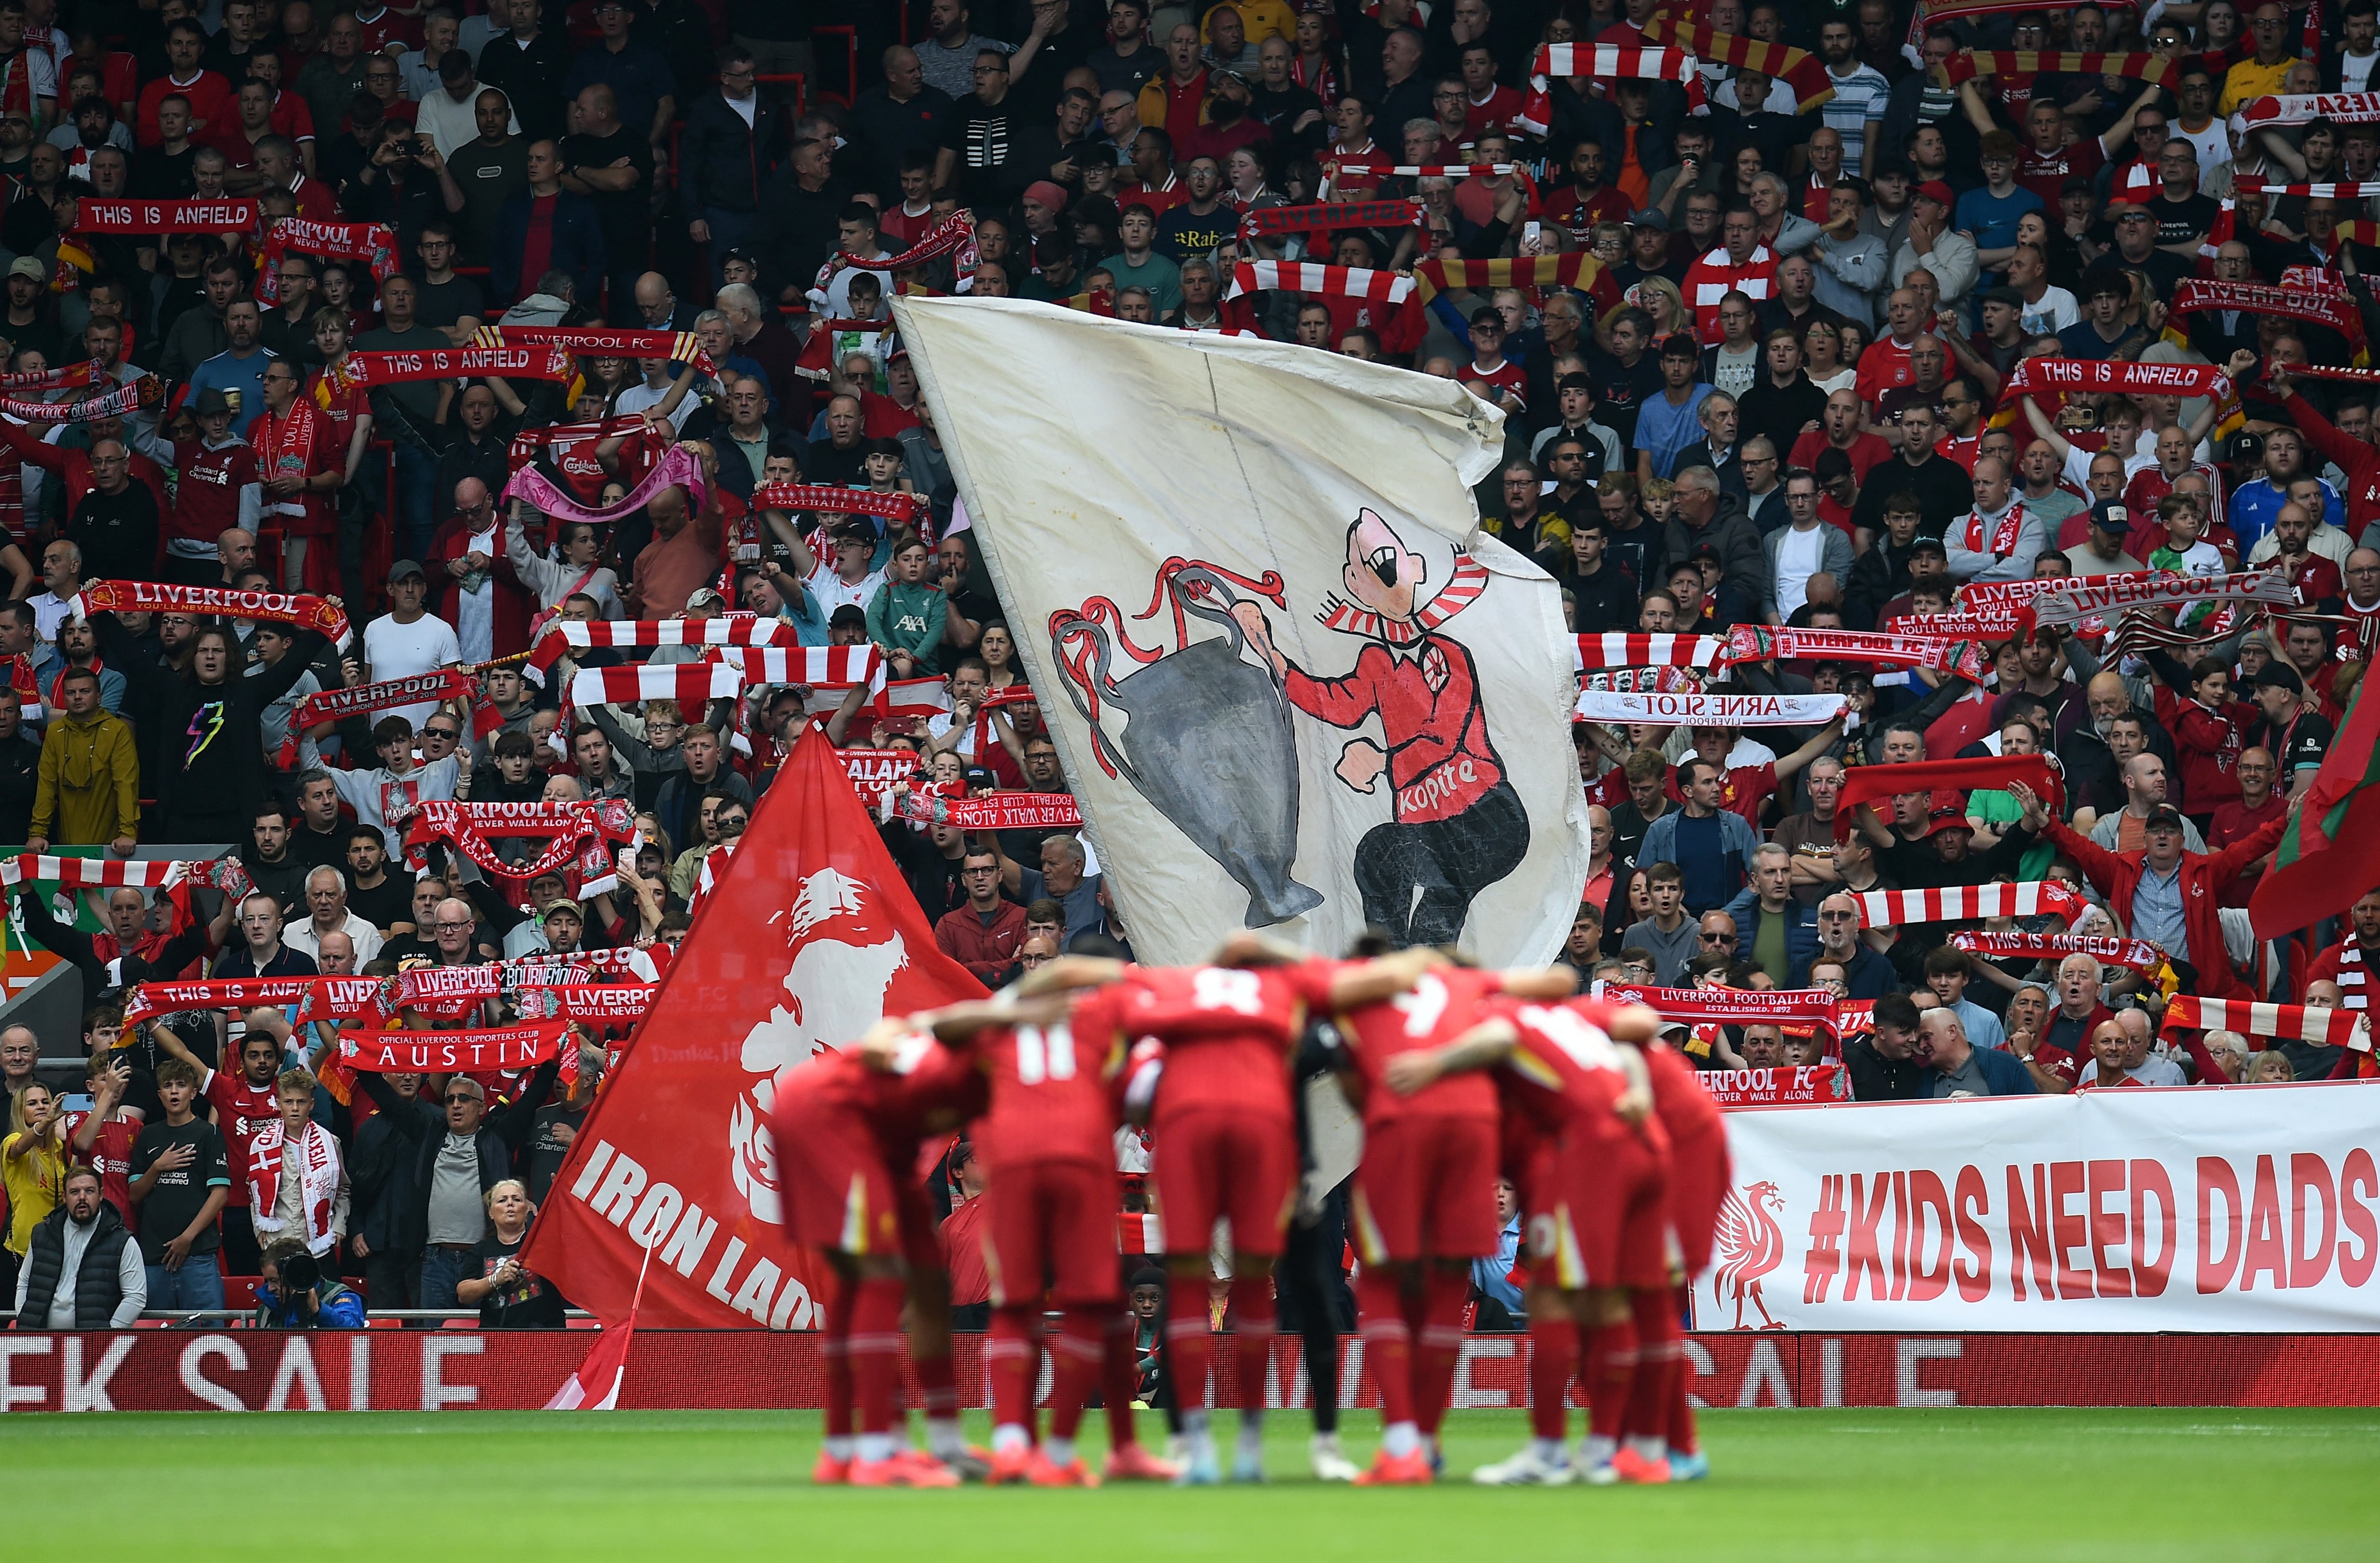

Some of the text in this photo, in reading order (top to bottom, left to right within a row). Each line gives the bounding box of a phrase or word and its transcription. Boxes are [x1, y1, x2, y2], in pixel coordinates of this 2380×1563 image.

[91, 206, 248, 224] THIS IS ANFIELD
[1261, 205, 1409, 228] LIVERPOOL
[295, 236, 351, 254] NEVER WALK
[2191, 283, 2331, 315] LIVERPOOL
[523, 334, 653, 349] LIVERPOOL FC
[382, 350, 529, 374] THIS IS ANFIELD
[2041, 362, 2199, 386] THIS IS ANFIELD
[1, 398, 66, 419] LIVERPOOL
[71, 384, 138, 418] BOURNEMOUTH
[2218, 404, 2244, 422] ANFIELD
[769, 499, 849, 509] FOOTBALL
[2106, 573, 2135, 586] FC
[132, 582, 297, 614] LIVERPOOL
[2069, 573, 2260, 612] LIVERPOOL FC
[135, 602, 294, 621] YOU'LL NEVER WALK ALONE
[1975, 600, 2015, 613] YOU'LL
[893, 615, 927, 632] AXA
[1898, 621, 2018, 635] YOU'LL NEVER WALK
[1795, 633, 1925, 653] LIVERPOOL FC
[314, 674, 452, 711] LIVERPOOL
[334, 702, 375, 715] CHAMPIONS
[390, 693, 418, 705] EUROPE
[420, 690, 438, 700] 2019
[840, 759, 913, 781] ALAH
[959, 803, 979, 811] 1892
[1003, 795, 1072, 807] FOOTBALL CLUB
[474, 819, 572, 828] EVER WALK ALON
[954, 810, 998, 826] ALONE
[1002, 807, 1038, 825] WALK
[1981, 931, 2120, 956] THIS IS ANFIELD
[415, 968, 497, 993] LIVERPOOL
[163, 982, 306, 1002] THIS IS ANFI
[432, 987, 498, 997] SATURDAY 21ST
[1661, 990, 1835, 1006] LIVERPOOL FOOTBALL CLUB
[411, 1002, 429, 1014] ALK
[567, 1004, 646, 1016] YOU'LL NEVER
[378, 1029, 539, 1045] OFFICIAL LIVERPOOL SUPPORTERS CLUB
[377, 1039, 538, 1067] AUSTIN
[1792, 1066, 1818, 1090] FC
[1712, 1090, 1814, 1102] NEVER WALK ALONE
[536, 1141, 569, 1152] Chartere
[570, 1138, 825, 1330] IRON LAD
[1803, 1148, 2379, 1305] #KIDS NEED DADS
